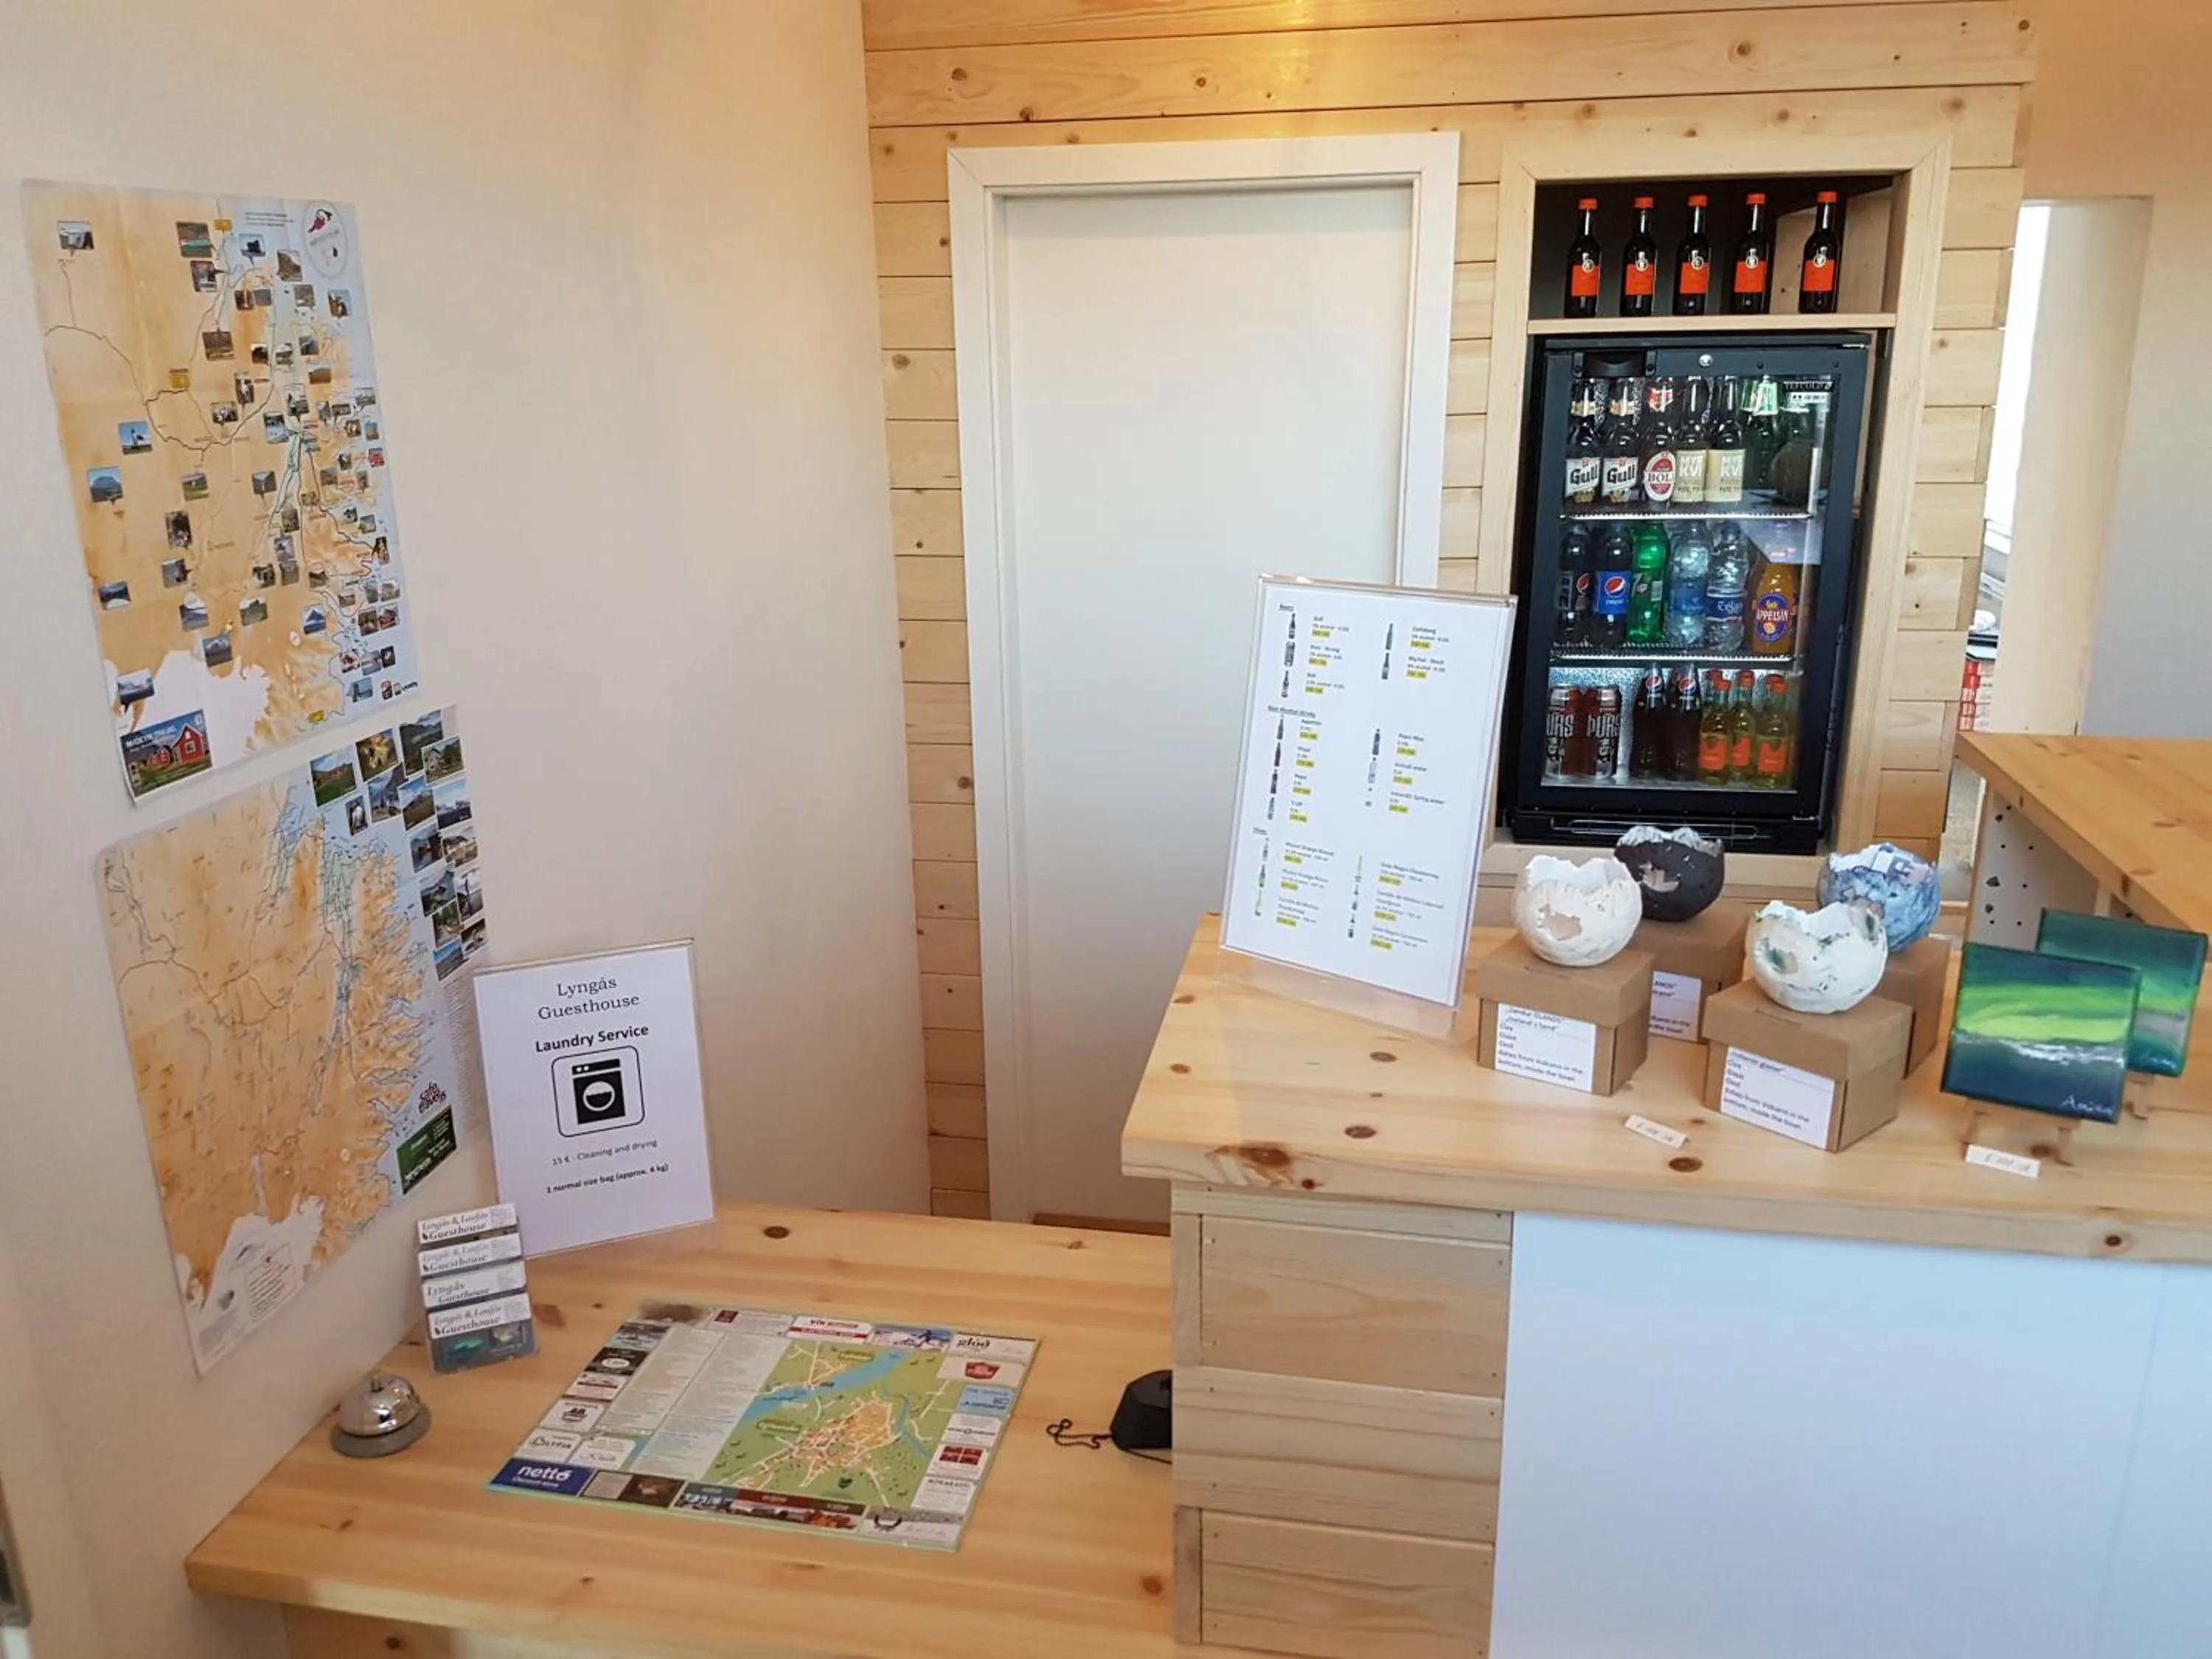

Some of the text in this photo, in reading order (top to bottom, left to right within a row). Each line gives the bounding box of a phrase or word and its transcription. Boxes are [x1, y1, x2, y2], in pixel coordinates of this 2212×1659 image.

[1570, 464, 1598, 484] Gull
[1607, 464, 1635, 484] Gull
[557, 977, 617, 998] Lyngás
[538, 993, 640, 1020] Guesthouse
[535, 1025, 649, 1053] Laundry Service
[577, 1148, 613, 1161] Cleaning
[615, 1144, 630, 1154] and
[632, 1140, 658, 1150] drying
[554, 1180, 582, 1192] normal
